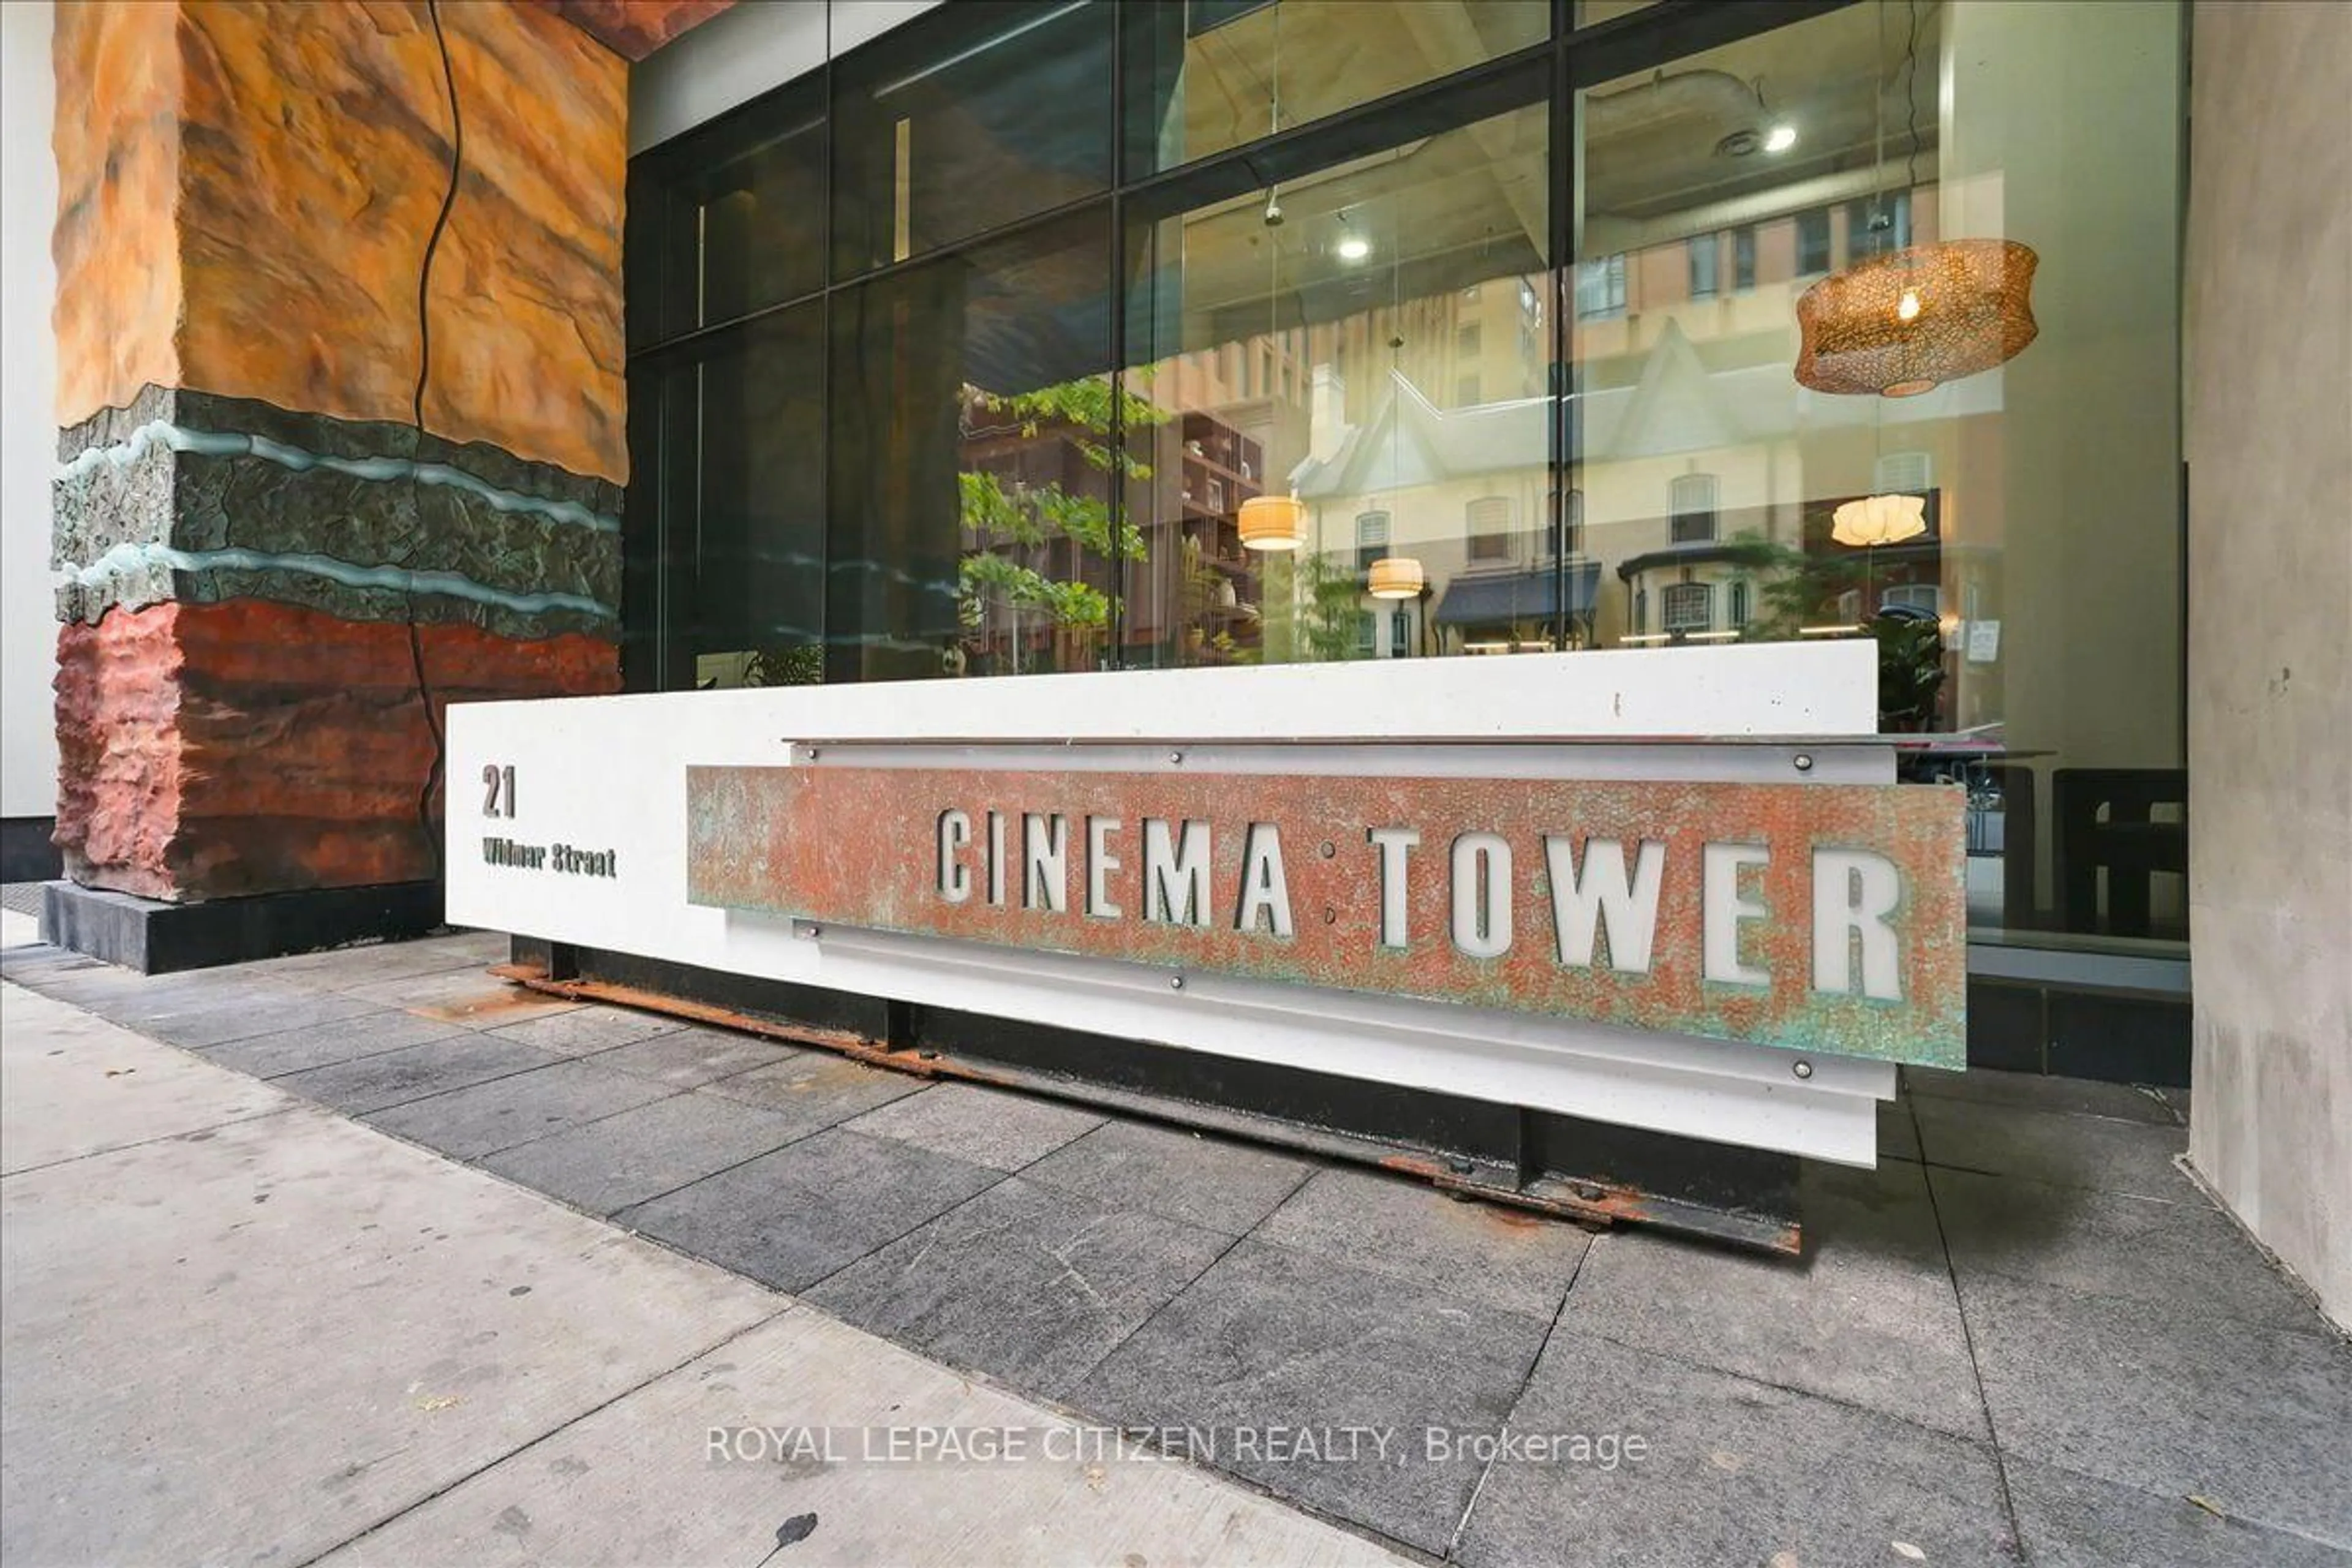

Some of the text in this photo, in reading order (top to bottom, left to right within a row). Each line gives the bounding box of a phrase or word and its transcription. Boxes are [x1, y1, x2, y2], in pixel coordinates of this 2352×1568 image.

[483, 764, 515, 819] 21
[937, 809, 1903, 1003] CINEMA TOWER
